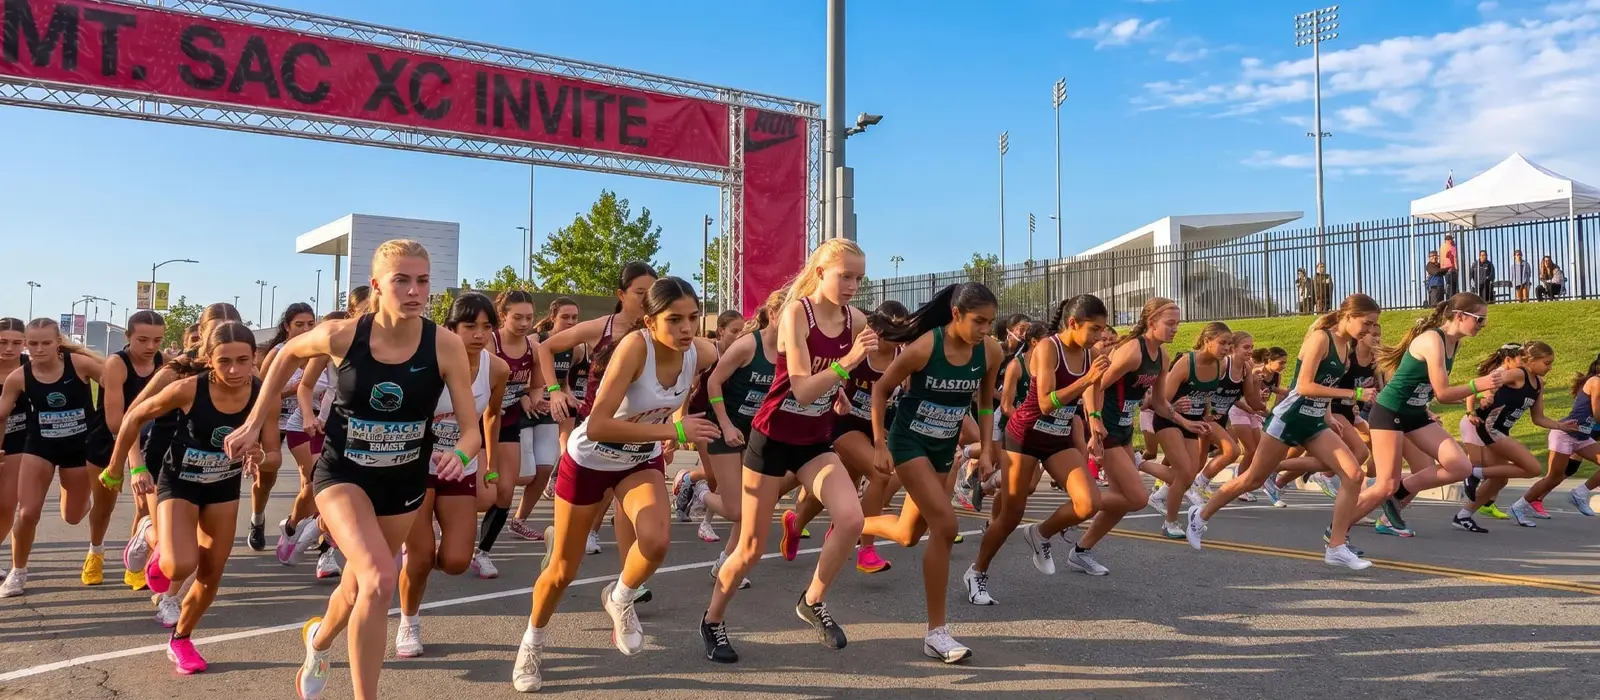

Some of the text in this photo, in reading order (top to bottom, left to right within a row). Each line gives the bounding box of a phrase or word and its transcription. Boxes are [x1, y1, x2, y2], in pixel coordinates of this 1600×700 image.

[3, 0, 648, 147] MT. SAC XC INVITE
